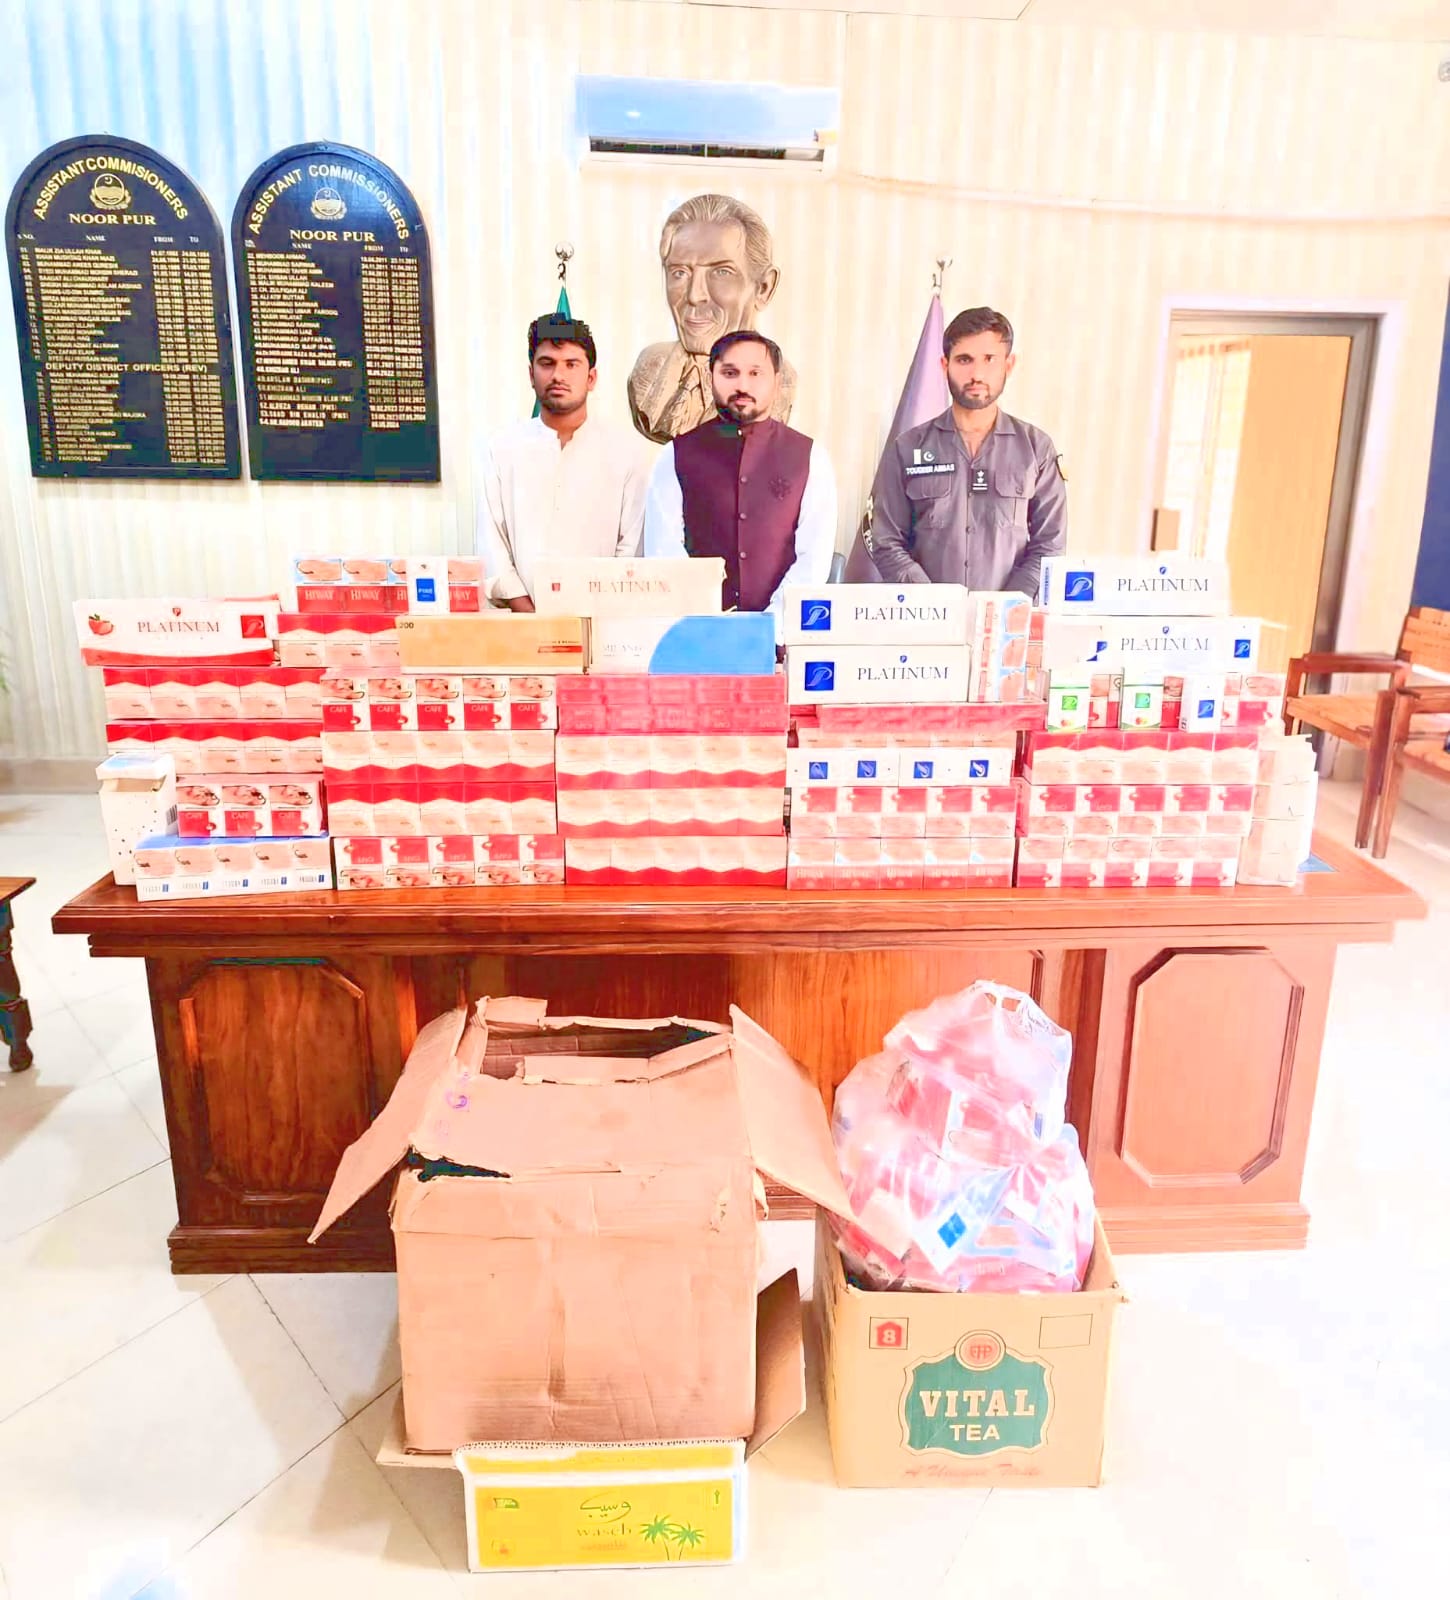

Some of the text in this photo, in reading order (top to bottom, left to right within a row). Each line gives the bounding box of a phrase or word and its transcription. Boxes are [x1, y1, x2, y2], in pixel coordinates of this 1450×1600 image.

[34, 156, 188, 220] ASSISTANT COMMISIONERS
[248, 164, 409, 240] ASSISTANT COMMISSIONERS
[69, 213, 157, 226] NOOR PUR
[290, 229, 376, 242] NOOR PUR
[292, 242, 312, 250] NAME
[364, 244, 384, 252] FROM
[45, 362, 207, 373] DEPUTY DISTRICT OFFICERS (REV)
[589, 581, 671, 593] PLATINUM
[1118, 578, 1209, 592] PLATINUM
[304, 590, 334, 600] HIWAY
[350, 590, 380, 600] HIWAY
[854, 607, 948, 621] PLATINUM
[138, 621, 220, 633] PLATINUM
[1121, 638, 1210, 651] PLATINUM
[857, 666, 950, 680] PLATINUM
[882, 1329, 896, 1344] 8
[919, 1389, 1035, 1417] VITAL
[949, 1424, 1000, 1441] TEA
[577, 1522, 632, 1536] waseb
